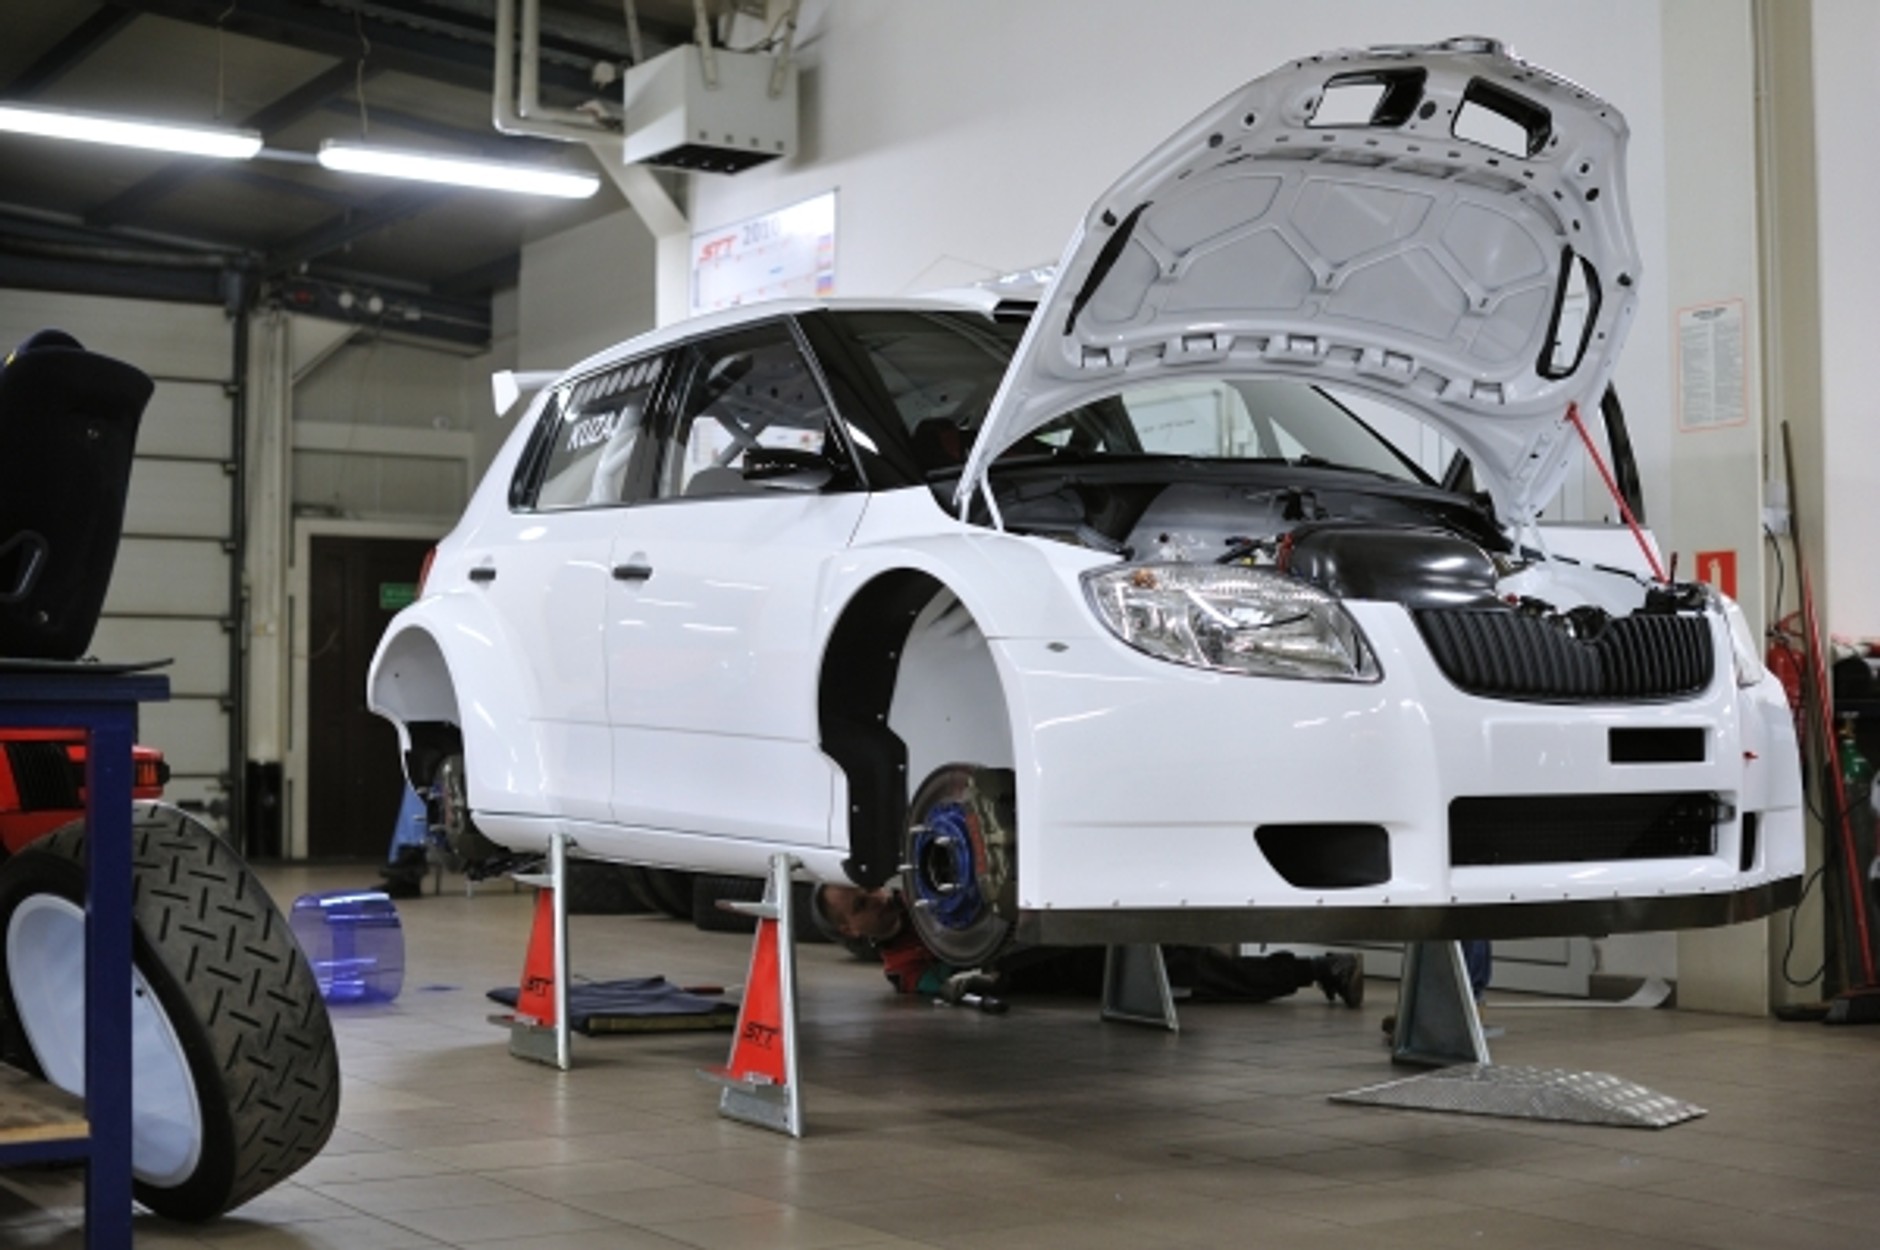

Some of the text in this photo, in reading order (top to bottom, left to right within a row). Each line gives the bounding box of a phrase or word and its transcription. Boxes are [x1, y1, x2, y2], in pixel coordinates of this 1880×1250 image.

[699, 217, 780, 263] STT 2010
[742, 1021, 779, 1048] STT
